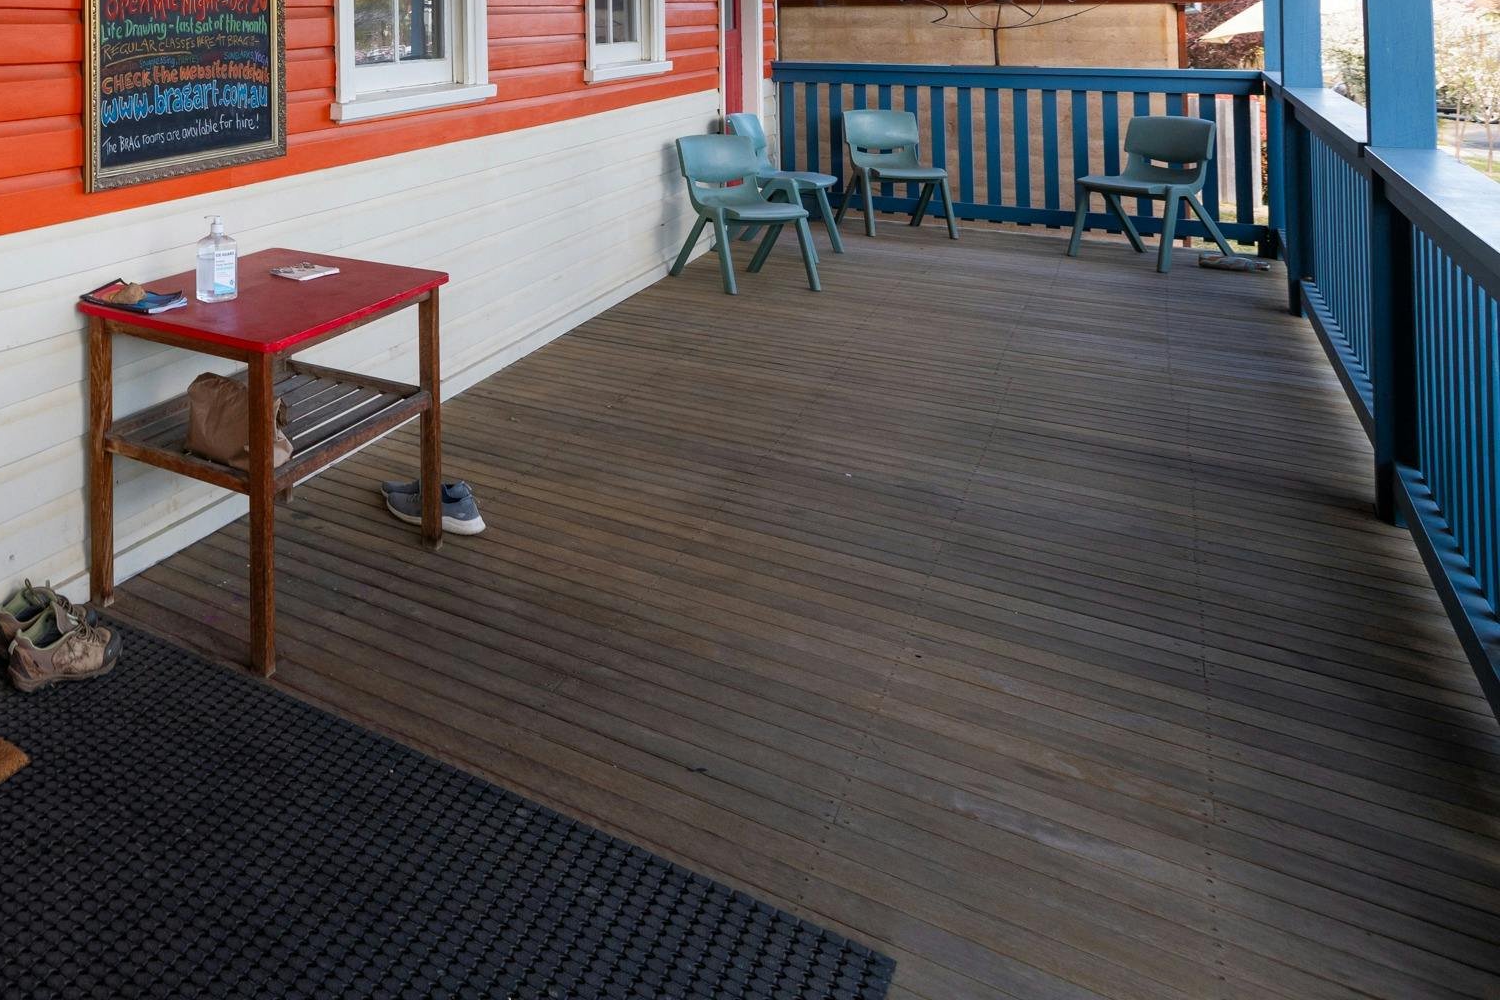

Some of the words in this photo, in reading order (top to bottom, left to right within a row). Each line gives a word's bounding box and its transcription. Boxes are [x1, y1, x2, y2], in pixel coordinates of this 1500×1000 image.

[101, 20, 122, 45] Life
[124, 16, 167, 41] Drawing
[176, 16, 194, 35] last
[214, 14, 225, 32] of
[226, 13, 241, 33] the
[101, 39, 156, 61] REGULAR
[196, 35, 215, 50] HERE
[215, 33, 226, 46] AT
[101, 68, 153, 95] CHECK
[153, 64, 178, 85] the
[179, 60, 228, 83] website
[228, 60, 243, 80] for
[101, 79, 268, 128] www.bragart.com.au
[102, 135, 118, 154] The
[119, 134, 141, 153] BRAG
[142, 131, 165, 146] rooms
[165, 129, 181, 143] are
[219, 112, 233, 131] for
[235, 112, 261, 132] hire!
